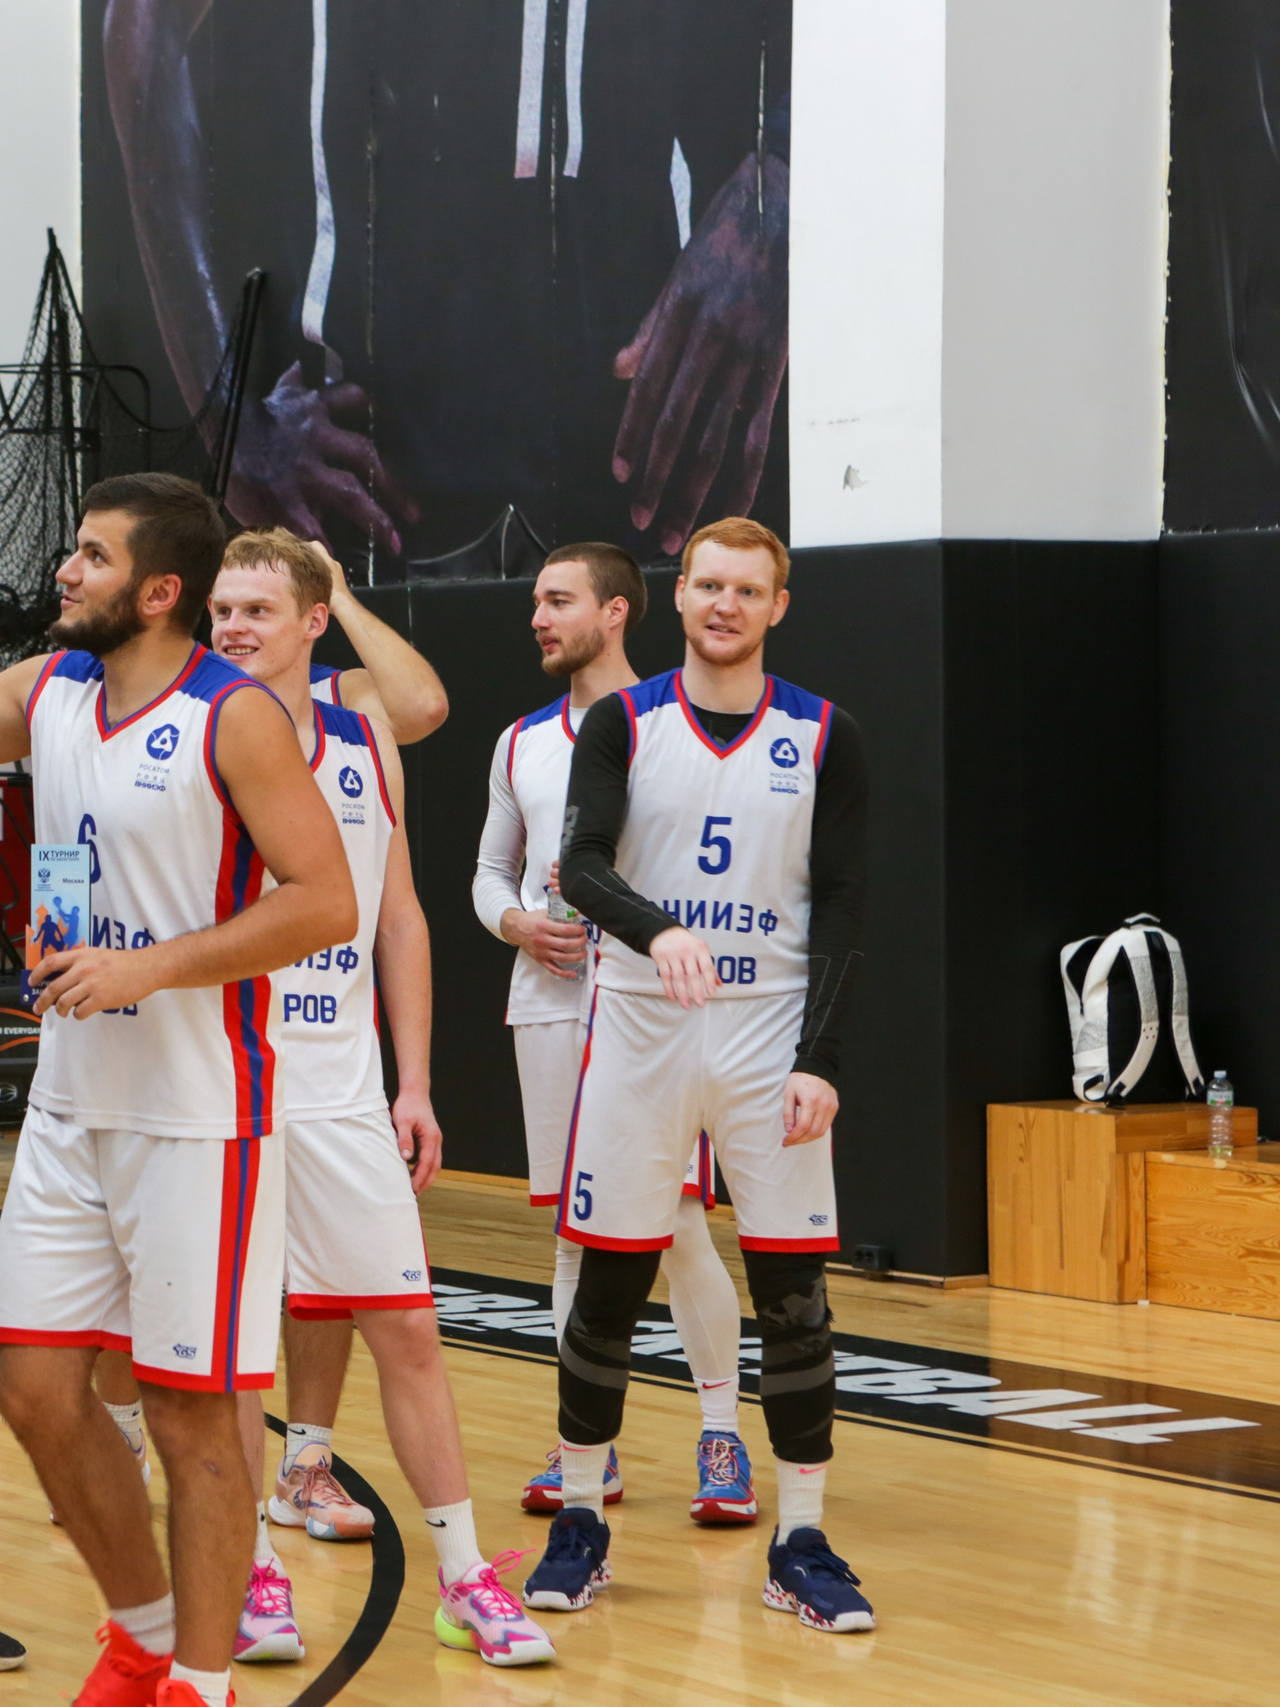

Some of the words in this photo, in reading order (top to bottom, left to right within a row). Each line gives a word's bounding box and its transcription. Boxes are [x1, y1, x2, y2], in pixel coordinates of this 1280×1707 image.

[38, 850, 50, 862] IX
[51, 850, 80, 858] ТУРНИР
[698, 815, 732, 875] 5
[658, 899, 779, 937] НИИЭФ
[283, 993, 337, 1023] РОВ
[4, 1027, 40, 1035] EVERYDAY
[574, 1170, 593, 1221] 5
